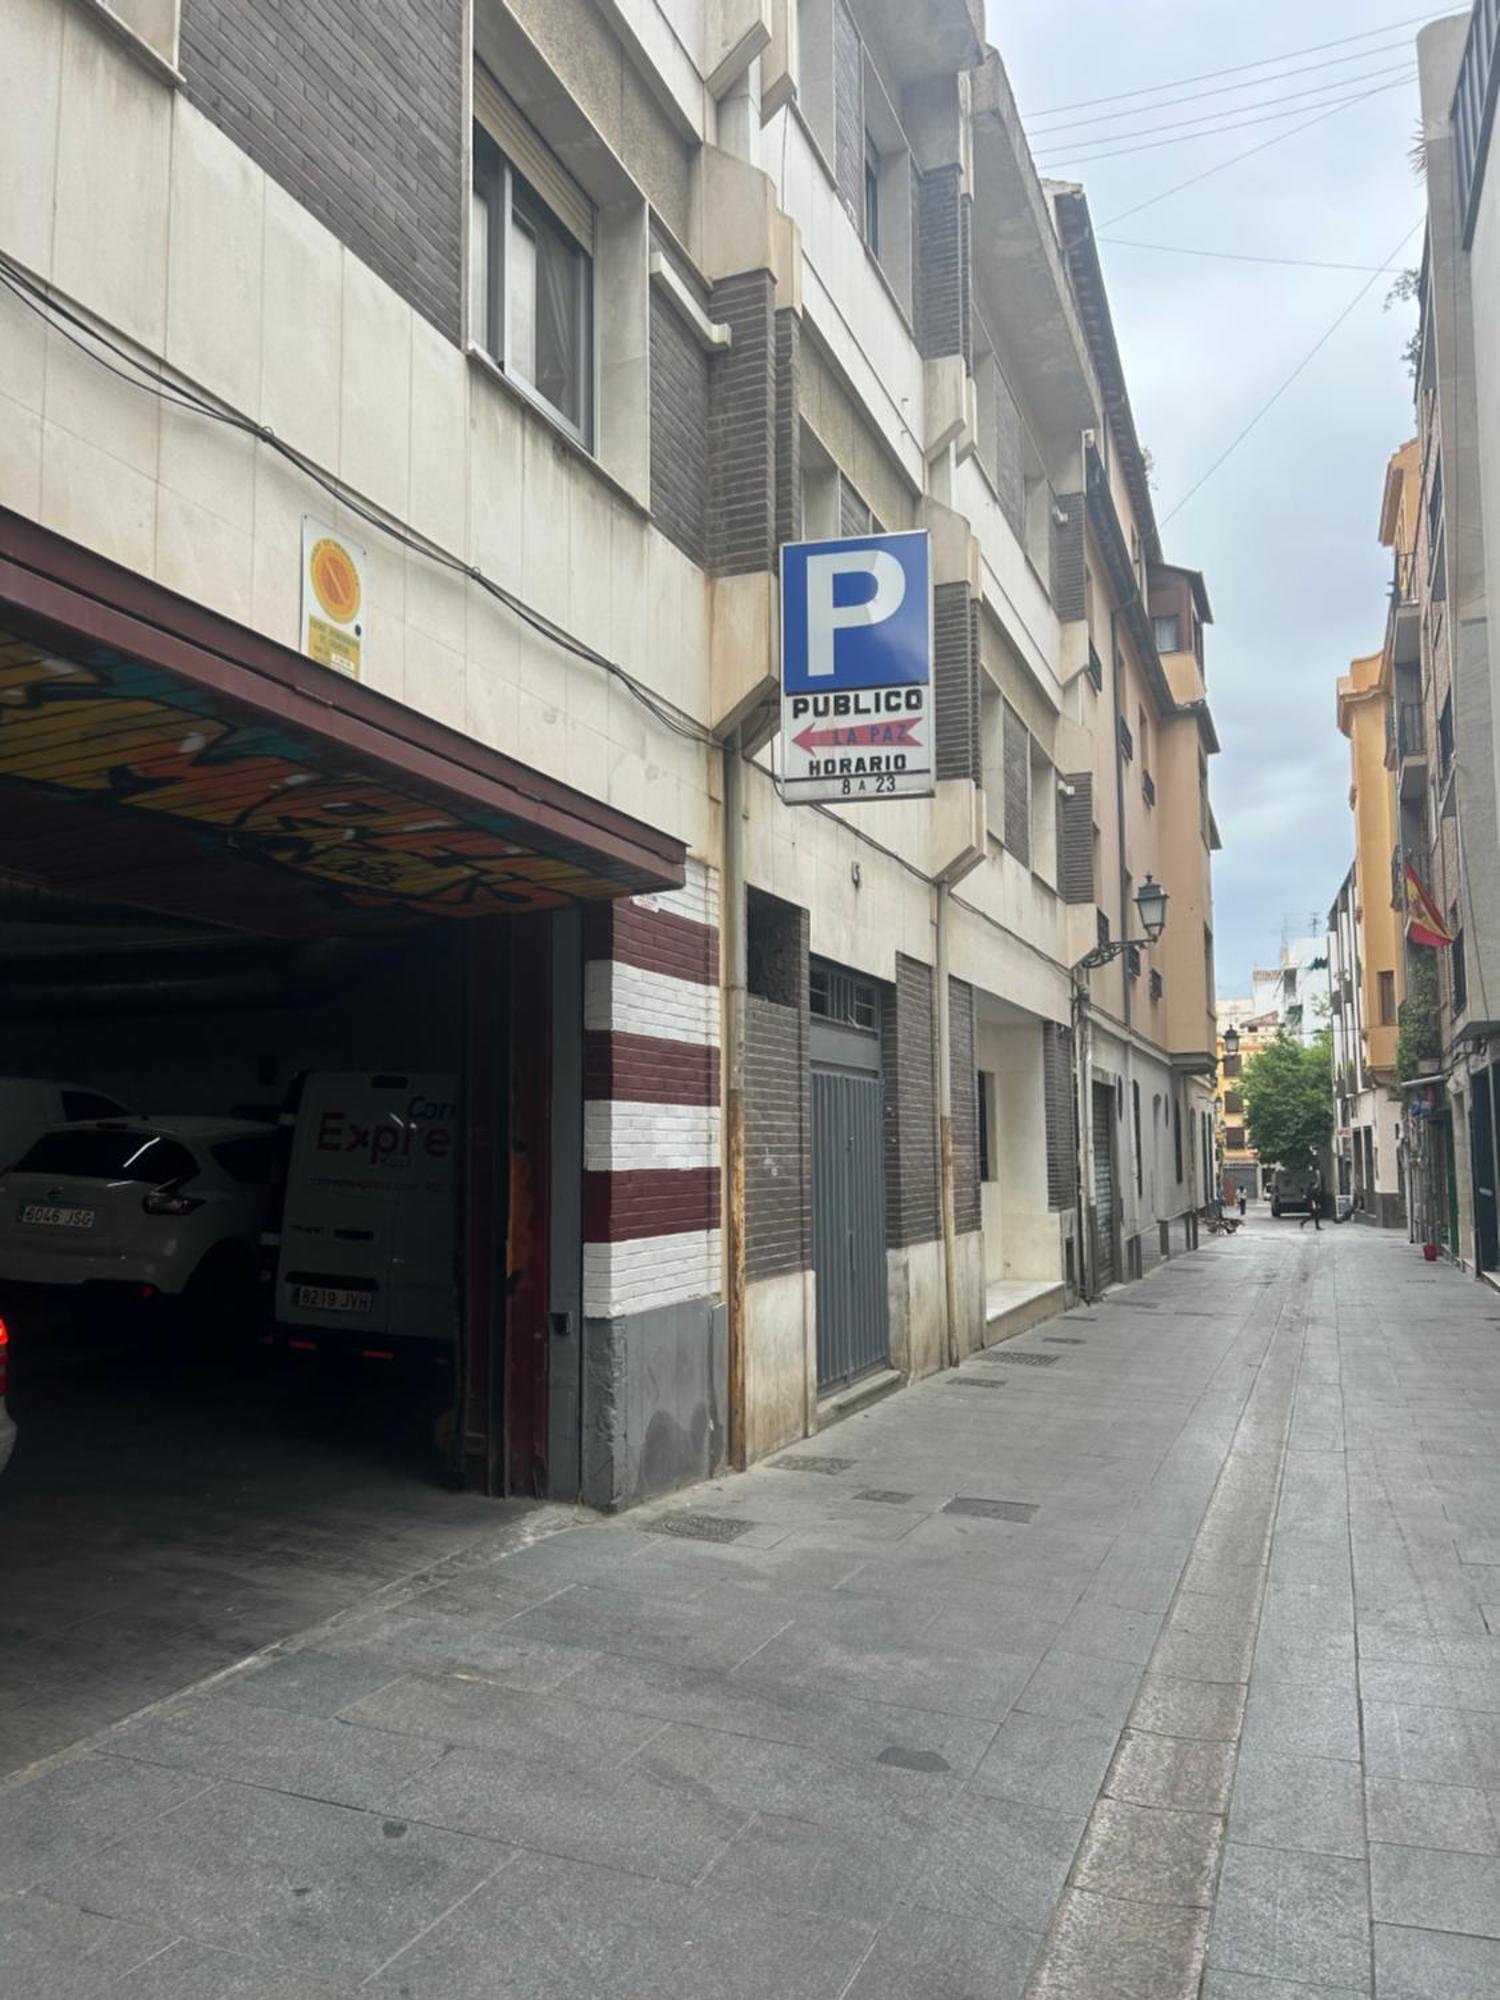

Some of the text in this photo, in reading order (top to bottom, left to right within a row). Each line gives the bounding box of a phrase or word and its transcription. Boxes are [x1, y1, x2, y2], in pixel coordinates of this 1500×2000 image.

[806, 549, 906, 677] P
[792, 689, 922, 719] PUBLICO
[832, 724, 908, 746] LA PAZ
[809, 754, 906, 776] HORARIO
[842, 775, 896, 795] 8 A 23
